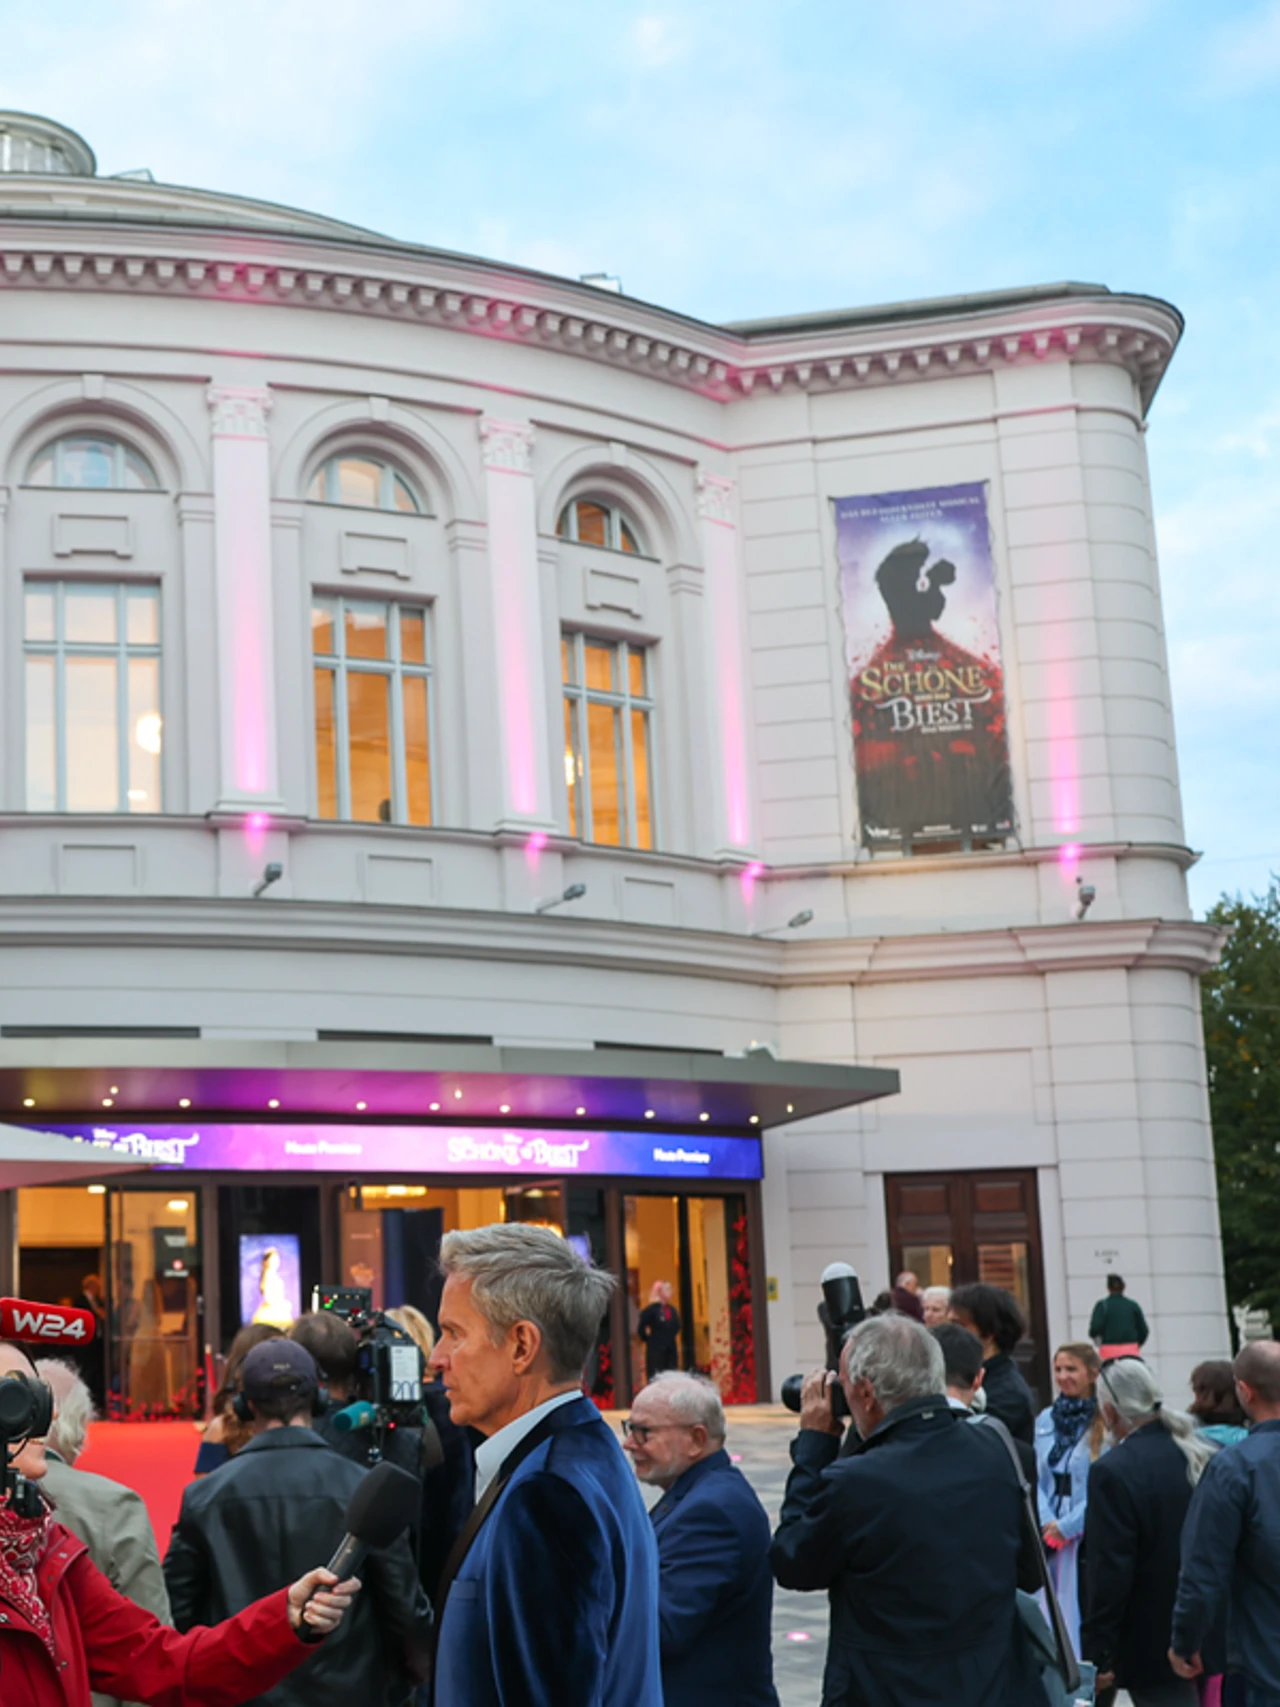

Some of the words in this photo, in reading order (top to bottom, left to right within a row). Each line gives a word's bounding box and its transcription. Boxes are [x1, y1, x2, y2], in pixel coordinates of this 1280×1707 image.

[861, 664, 985, 701] SCHÖNE
[879, 697, 980, 732] BIEST
[12, 1308, 87, 1341] W24
